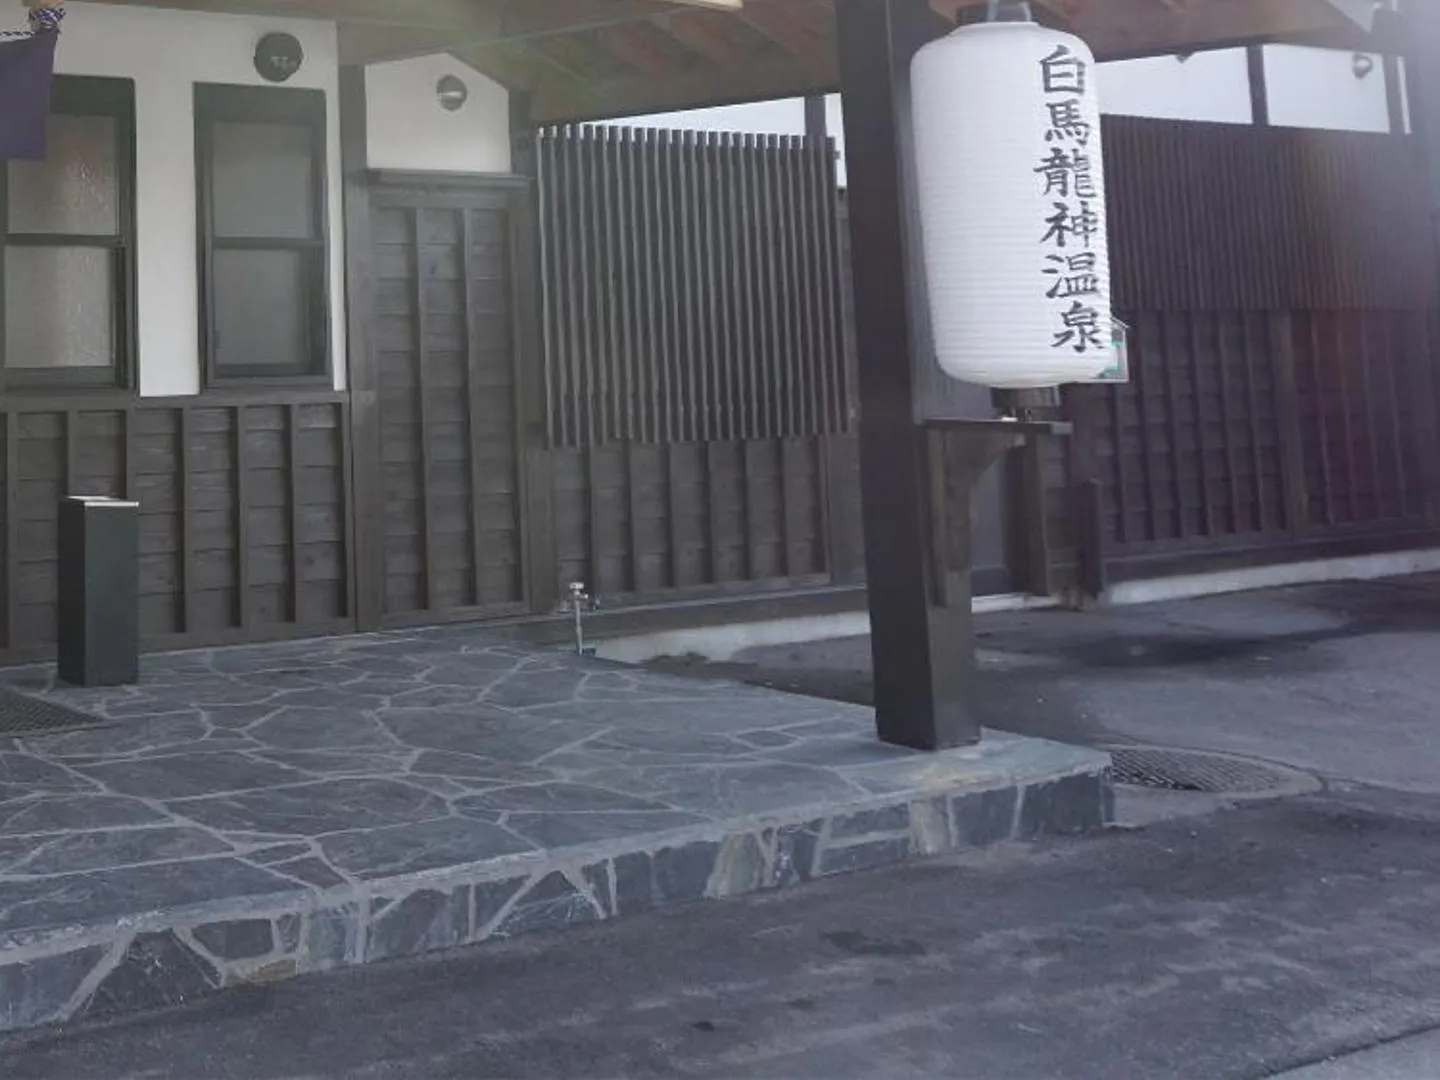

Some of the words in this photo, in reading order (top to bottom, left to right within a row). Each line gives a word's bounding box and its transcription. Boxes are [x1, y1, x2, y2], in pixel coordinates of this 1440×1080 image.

[1033, 45, 1107, 354] 白馬龍神温泉
